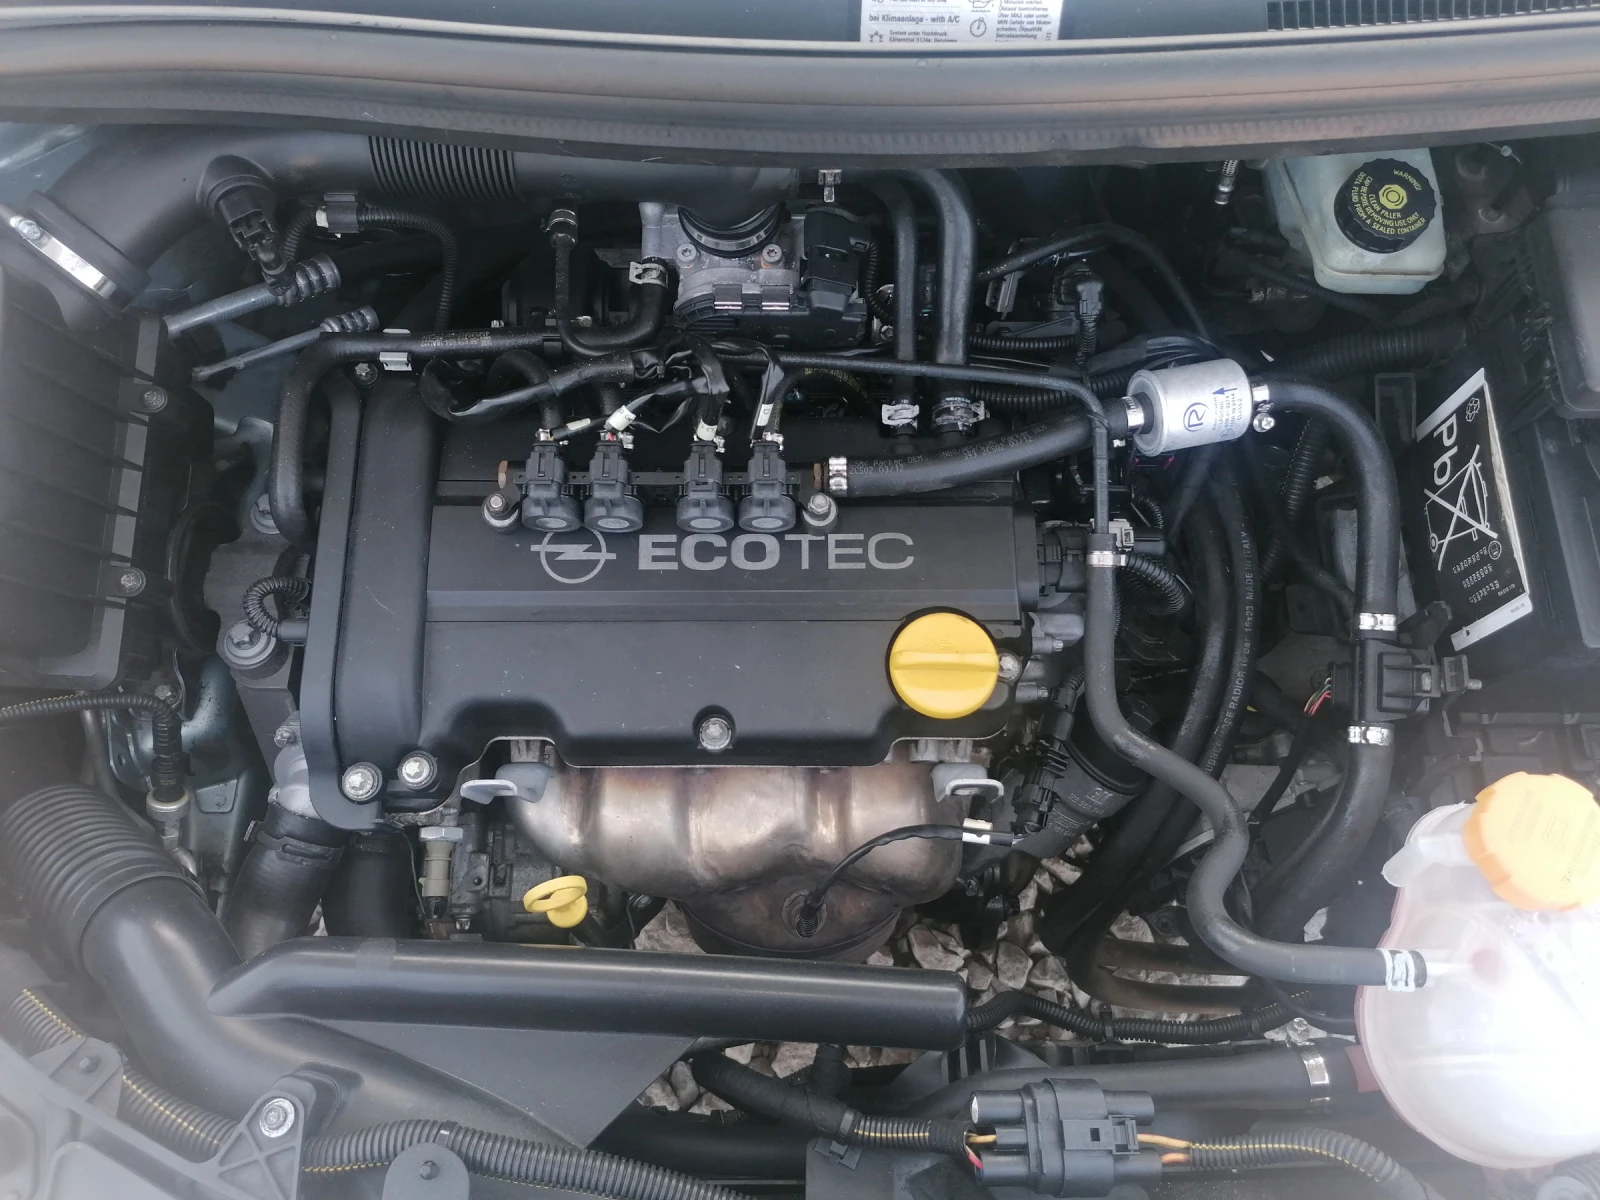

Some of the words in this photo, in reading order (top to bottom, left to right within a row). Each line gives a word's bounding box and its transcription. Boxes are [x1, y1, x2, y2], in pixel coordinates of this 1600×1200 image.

[882, 14, 924, 24] Klimaanlage
[1364, 176, 1373, 187] CAP
[1393, 169, 1422, 190] WARNING!
[1360, 186, 1369, 207] BEFORE
[1369, 193, 1380, 211] CLEAN
[1380, 210, 1401, 219] FILLER
[1354, 204, 1367, 220] FROM
[1372, 222, 1395, 234] SEALED
[1398, 217, 1426, 234] CONTAINER
[1406, 212, 1419, 224] ONLY
[874, 459, 903, 467] Parker
[908, 456, 924, 464] OEM
[1434, 414, 1458, 486] Pb
[878, 464, 904, 474] 03/12
[638, 532, 914, 571] ECOTEC
[1240, 531, 1252, 558] ITALY
[1246, 572, 1254, 600] MADE
[1204, 743, 1222, 774] UBBER
